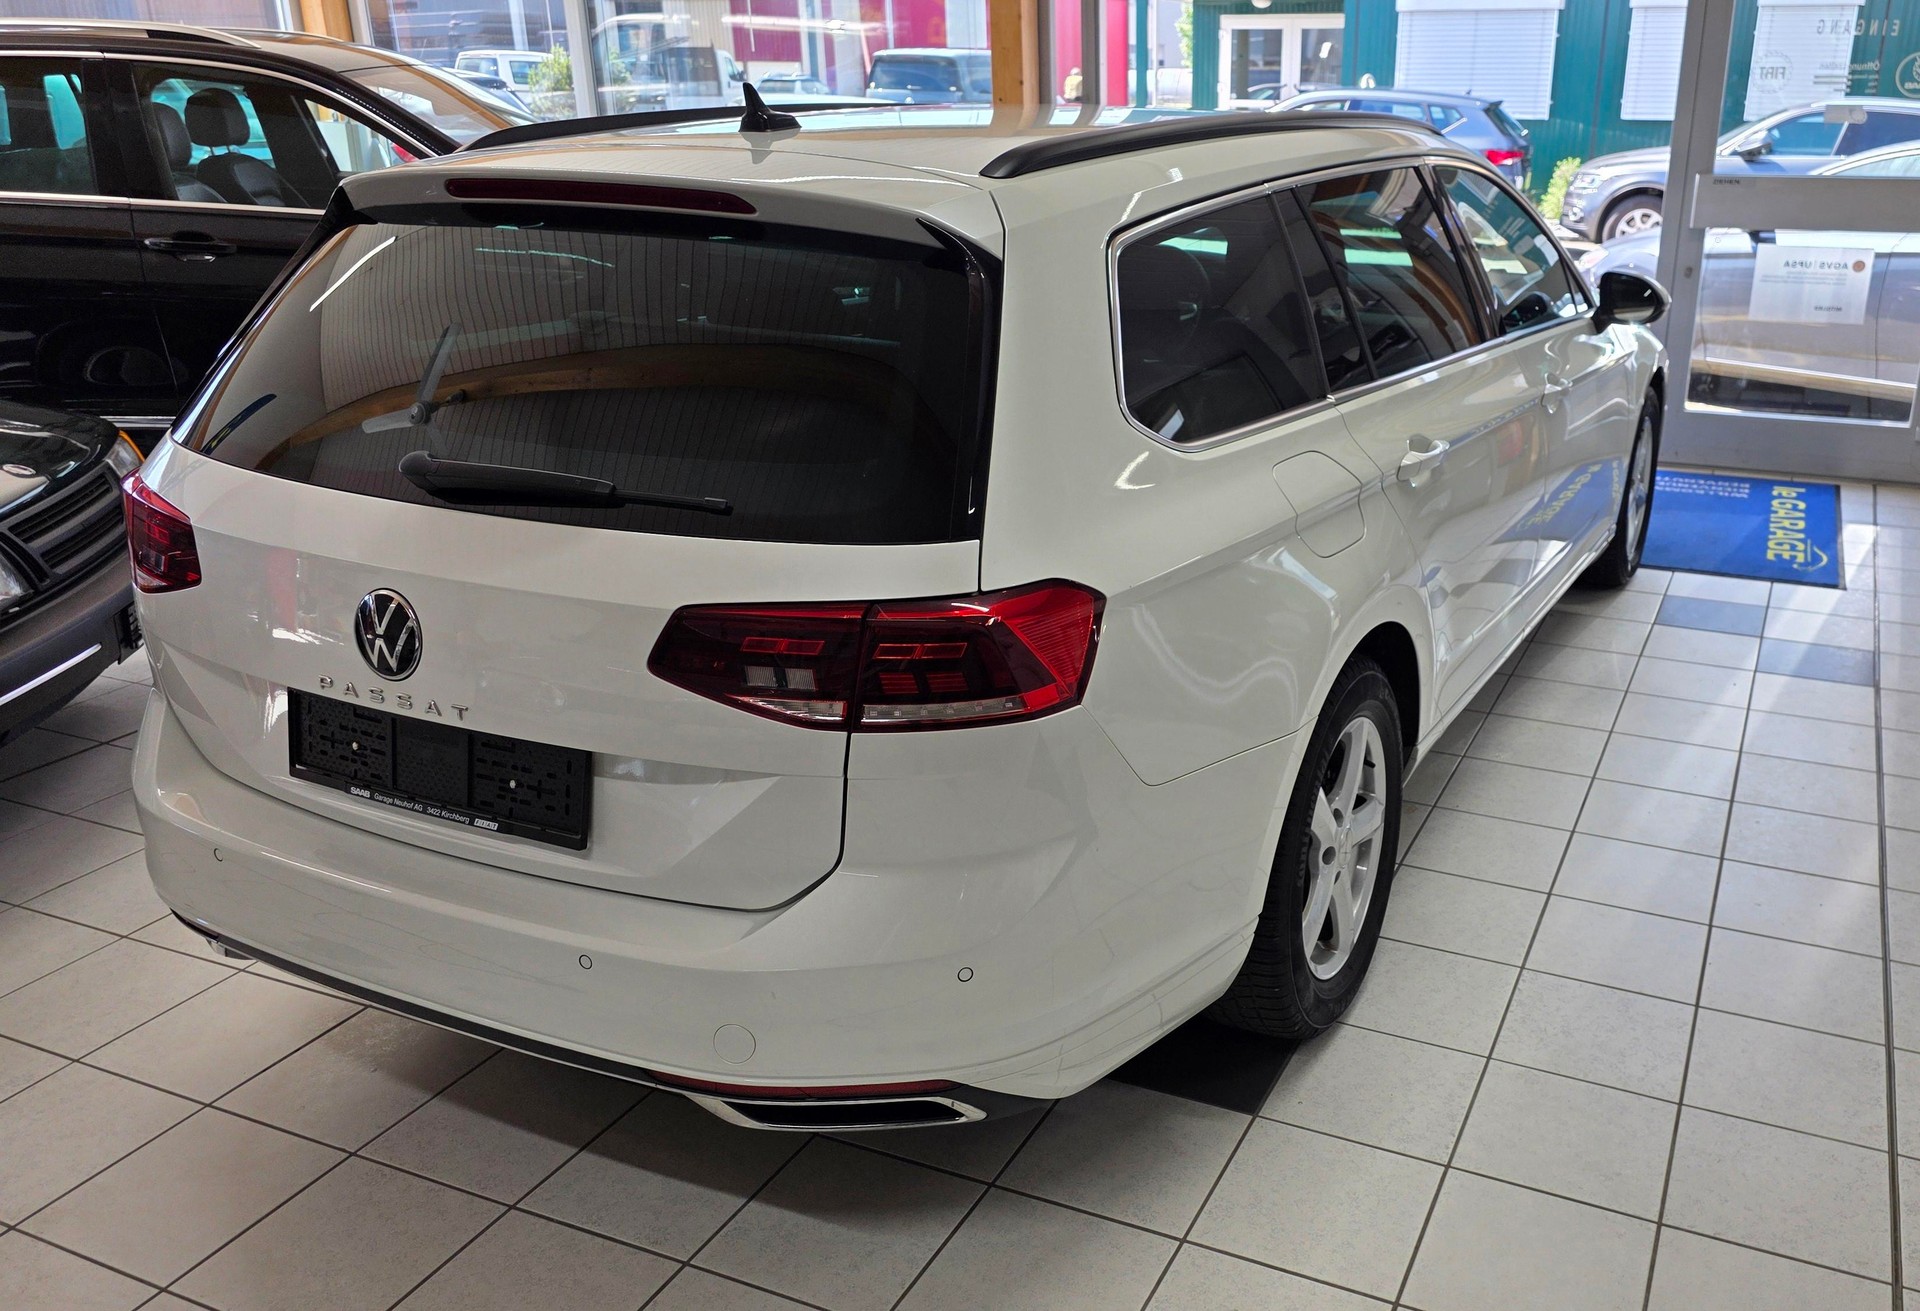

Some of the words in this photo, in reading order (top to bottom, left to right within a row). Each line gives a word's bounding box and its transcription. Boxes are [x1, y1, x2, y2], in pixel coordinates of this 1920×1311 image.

[1766, 498, 1807, 563] GARAGE
[318, 674, 469, 721] PASSAT
[350, 786, 371, 798] SAAB
[374, 792, 394, 805] Garage
[394, 798, 414, 809] Neuhof
[413, 803, 423, 812] AG
[426, 806, 441, 816] 3422
[441, 810, 470, 824] Kirchberg
[473, 818, 499, 830] FIAT
